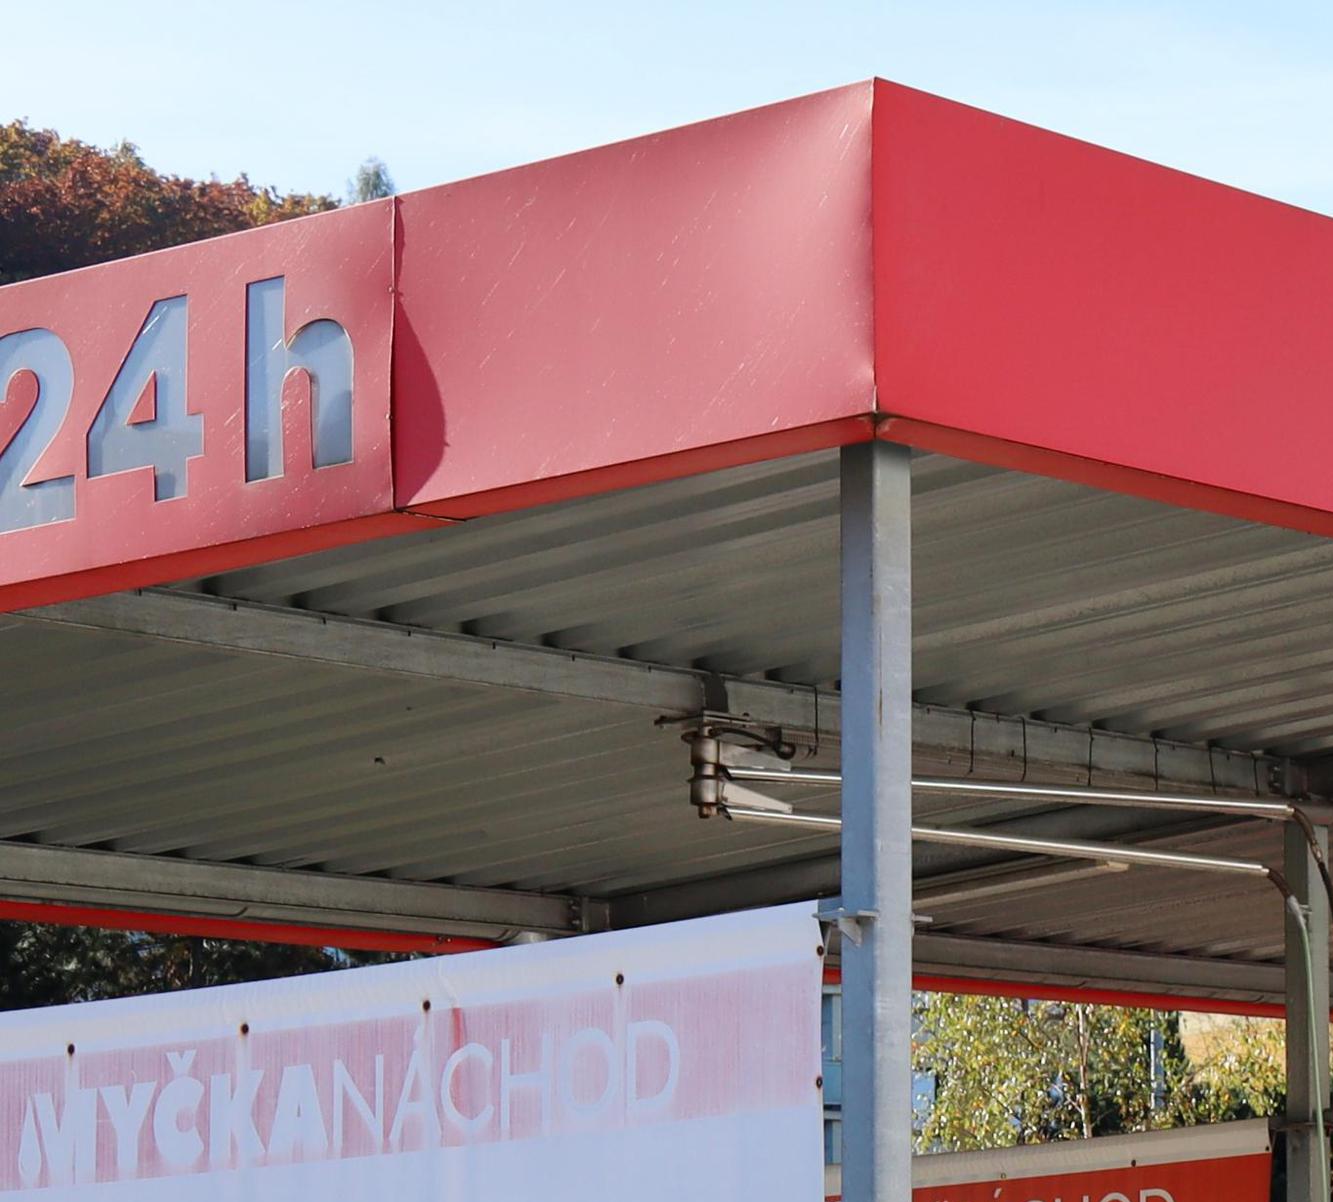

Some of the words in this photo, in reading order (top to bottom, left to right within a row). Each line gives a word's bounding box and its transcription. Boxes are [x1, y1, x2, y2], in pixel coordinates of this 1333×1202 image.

[0, 294, 205, 534] 24
[244, 274, 356, 484] h
[19, 1019, 681, 1187] MYČKANÁCHOD
